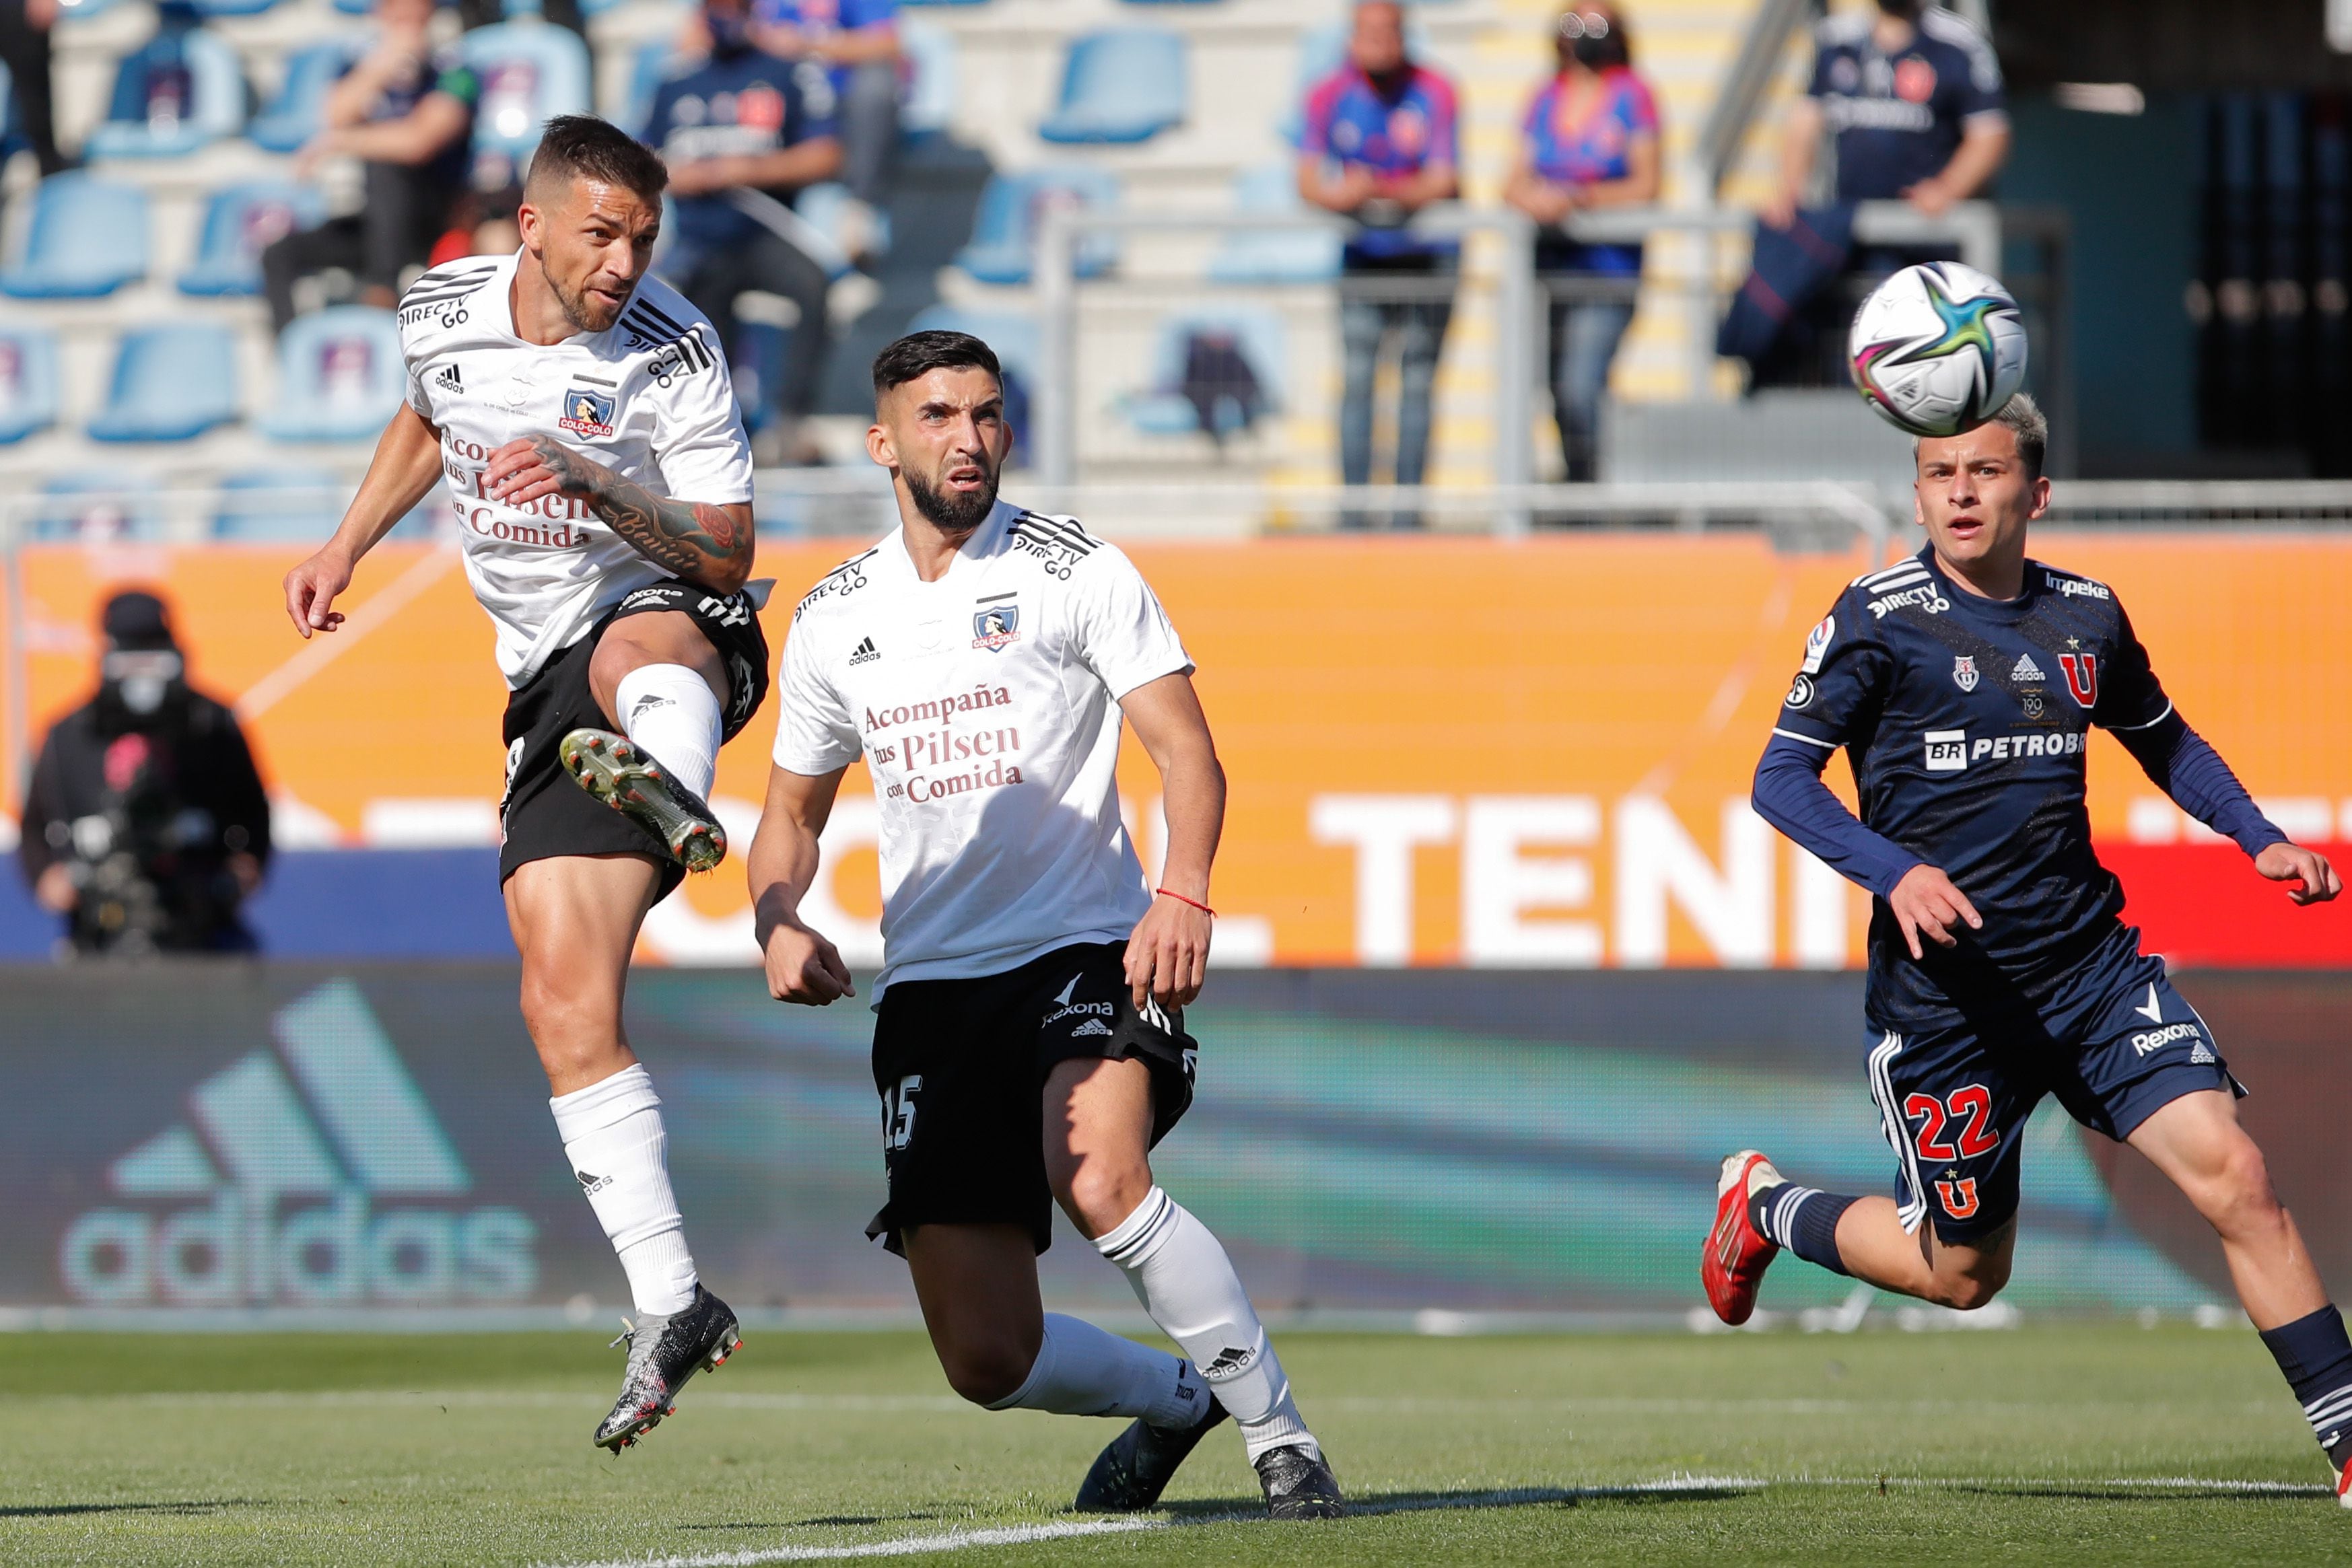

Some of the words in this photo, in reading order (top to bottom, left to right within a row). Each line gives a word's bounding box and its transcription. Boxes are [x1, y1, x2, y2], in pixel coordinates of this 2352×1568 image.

[399, 294, 469, 331] DIRECTV
[442, 309, 469, 328] GO
[436, 377, 464, 394] adidas
[648, 361, 672, 388] GO
[560, 419, 611, 436] COLO-COLO
[1044, 561, 1071, 581] GO
[618, 588, 683, 611] exona
[795, 563, 862, 624] DIRECTV
[840, 576, 867, 596] GO
[1867, 582, 1939, 620] DIRECTV
[1923, 598, 1950, 614] GO
[973, 633, 1020, 648] COLO-COLO
[849, 652, 881, 666] adidas
[2011, 668, 2046, 681] adidas
[865, 682, 1012, 733] Acompaña
[2022, 698, 2042, 711] 190
[874, 744, 895, 765] tus
[901, 725, 1021, 772] Pilsen
[1931, 743, 1962, 760] BR
[887, 781, 903, 799] con
[906, 758, 1025, 803] Comida
[1042, 1001, 1113, 1030] Rexona
[2131, 1024, 2201, 1057] Rexona
[884, 1075, 923, 1151] 15
[1904, 1083, 2000, 1162] 22
[59, 1182, 537, 1302] adidas
[1202, 1346, 1256, 1380] adidas
